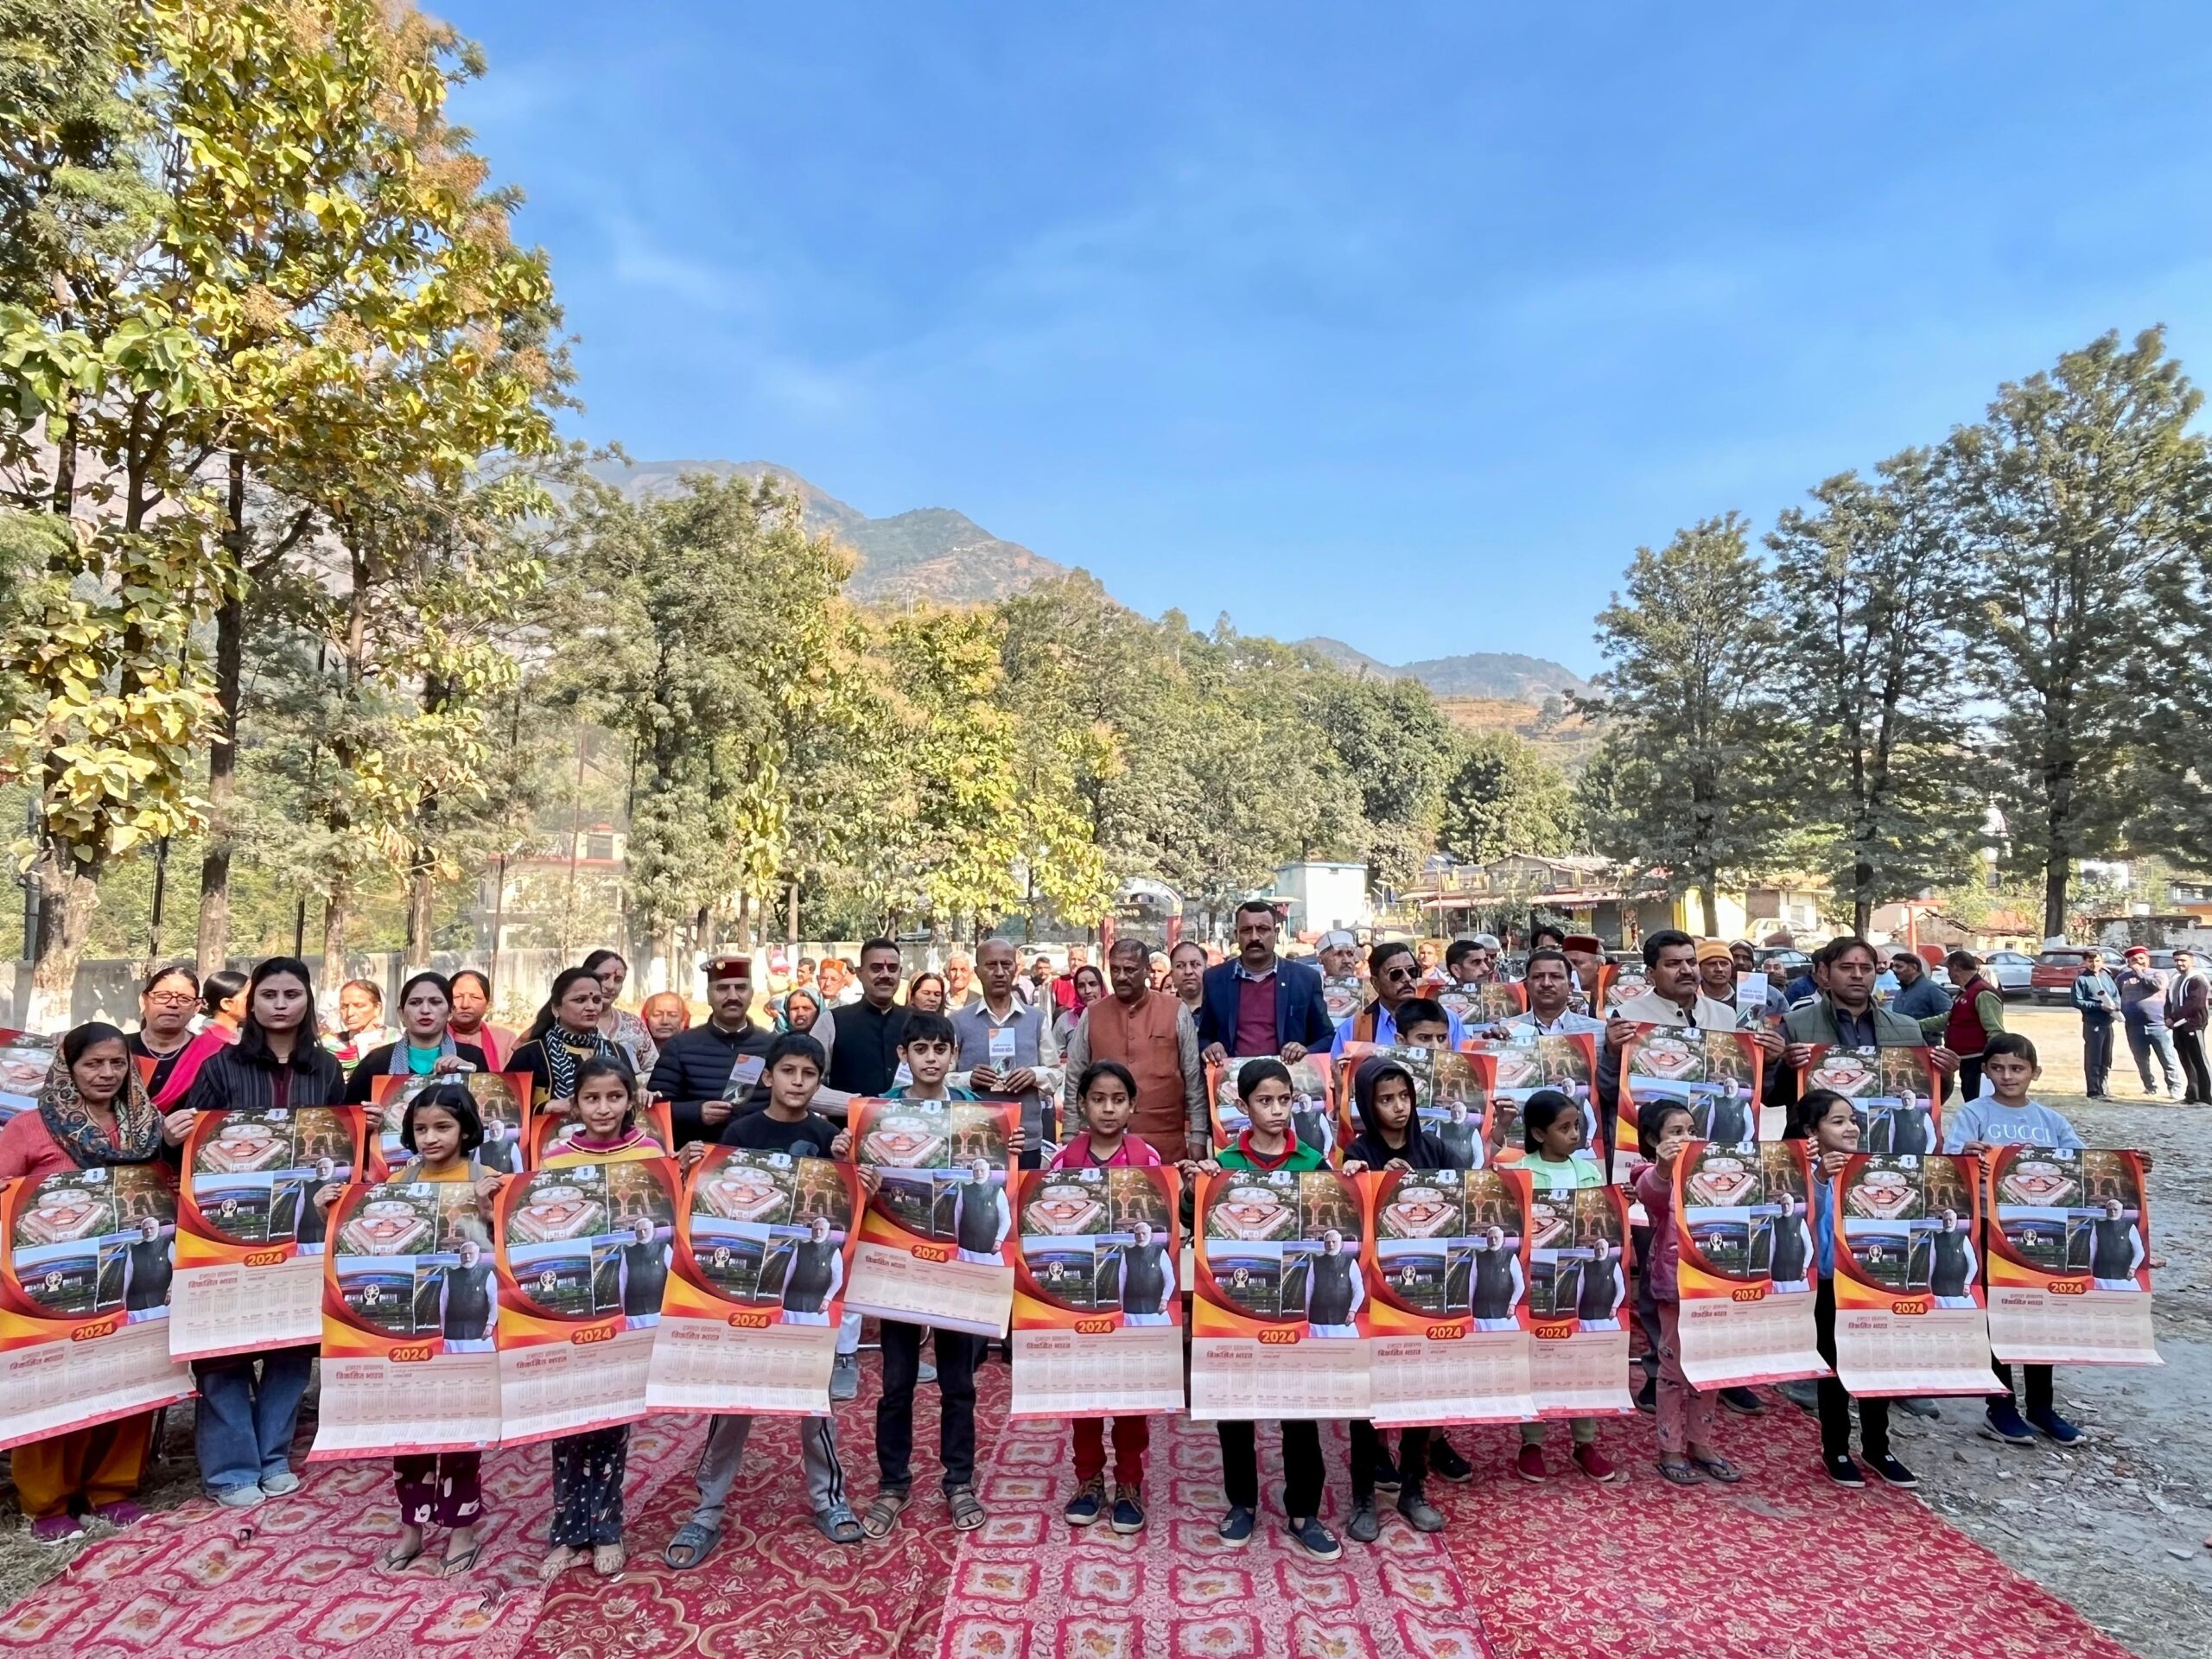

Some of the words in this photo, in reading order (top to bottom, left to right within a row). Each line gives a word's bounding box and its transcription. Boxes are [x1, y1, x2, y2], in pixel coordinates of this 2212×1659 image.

[1988, 1124, 2052, 1143] GUCCI
[248, 1253, 283, 1266] 2024
[914, 1246, 945, 1262] 2024
[1735, 1288, 1761, 1300] 2024
[2051, 1283, 2083, 1294] 2024
[1895, 1303, 1925, 1313] 2024
[732, 1313, 767, 1326] 2024
[75, 1323, 113, 1340] 2024
[1078, 1321, 1111, 1333] 2024
[1430, 1327, 1462, 1338] 2024
[1539, 1328, 1568, 1338] 2024
[575, 1328, 612, 1344] 2024
[1262, 1331, 1295, 1343] 2024
[393, 1348, 429, 1361] 2024
